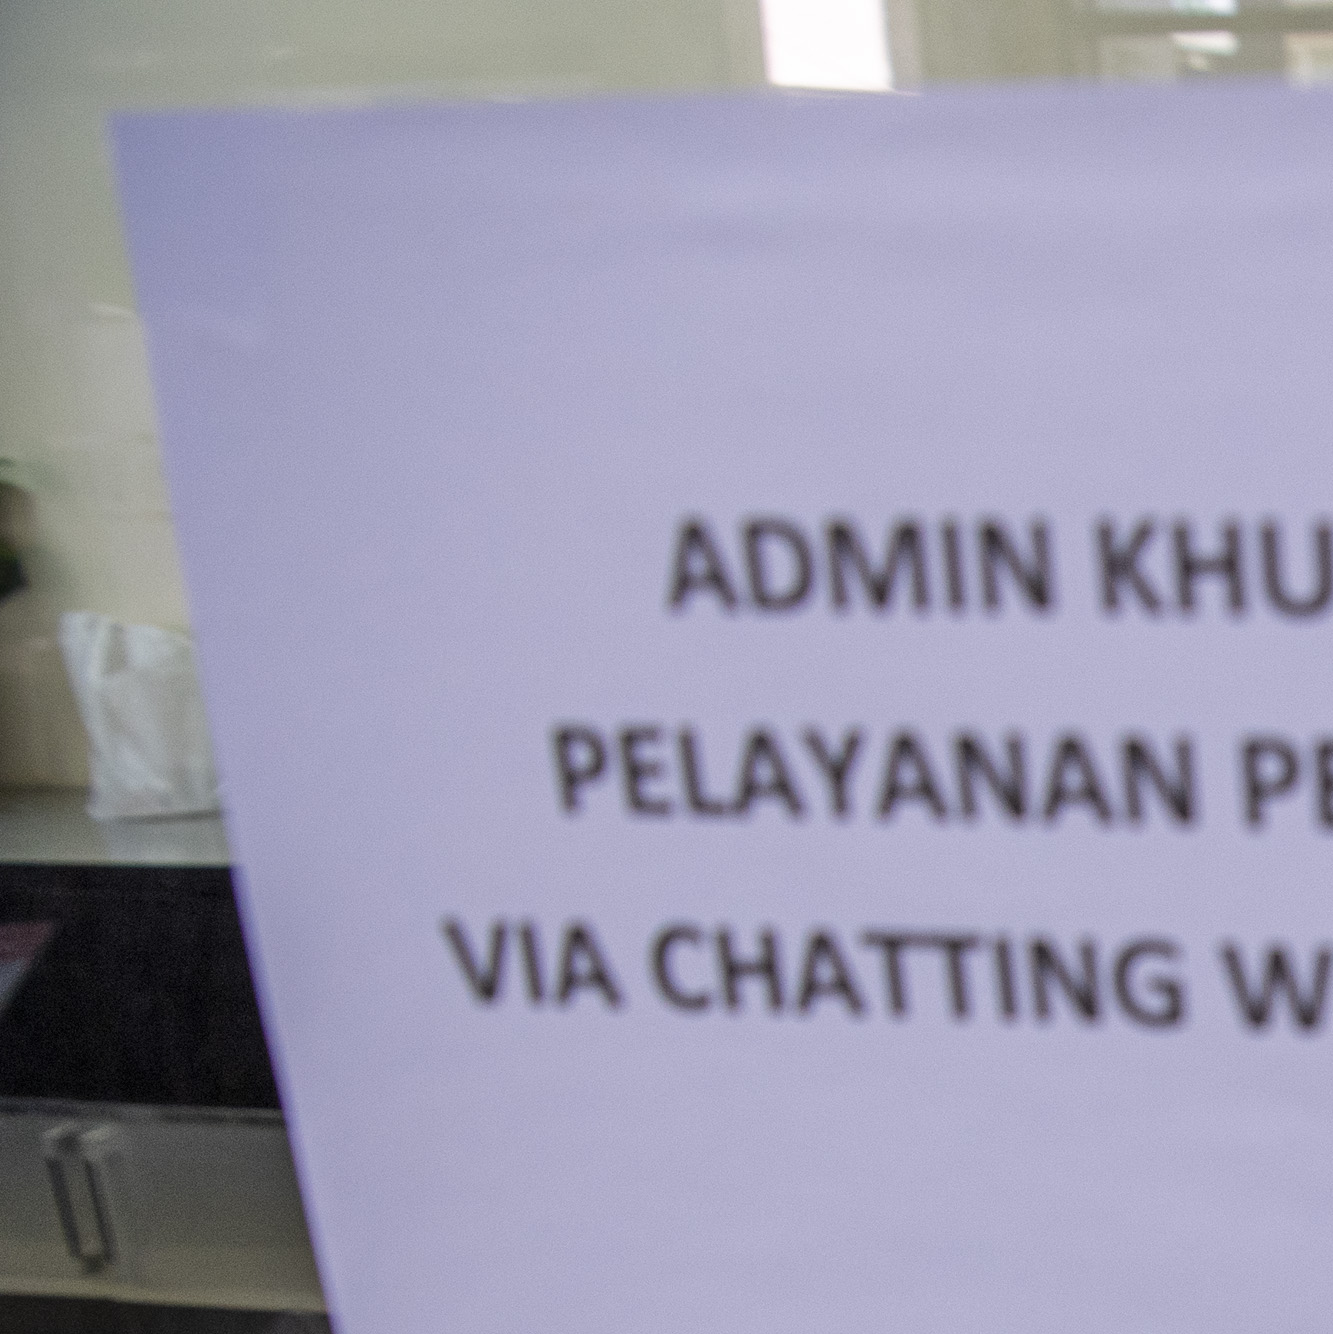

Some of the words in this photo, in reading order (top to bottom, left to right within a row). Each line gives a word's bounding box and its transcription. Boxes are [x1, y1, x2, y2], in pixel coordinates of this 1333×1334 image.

[669, 518, 1055, 613] ADMIN
[552, 725, 1198, 827] PELAYANAN
[443, 920, 622, 1008] VIA
[650, 924, 1186, 1029] CHATTING
